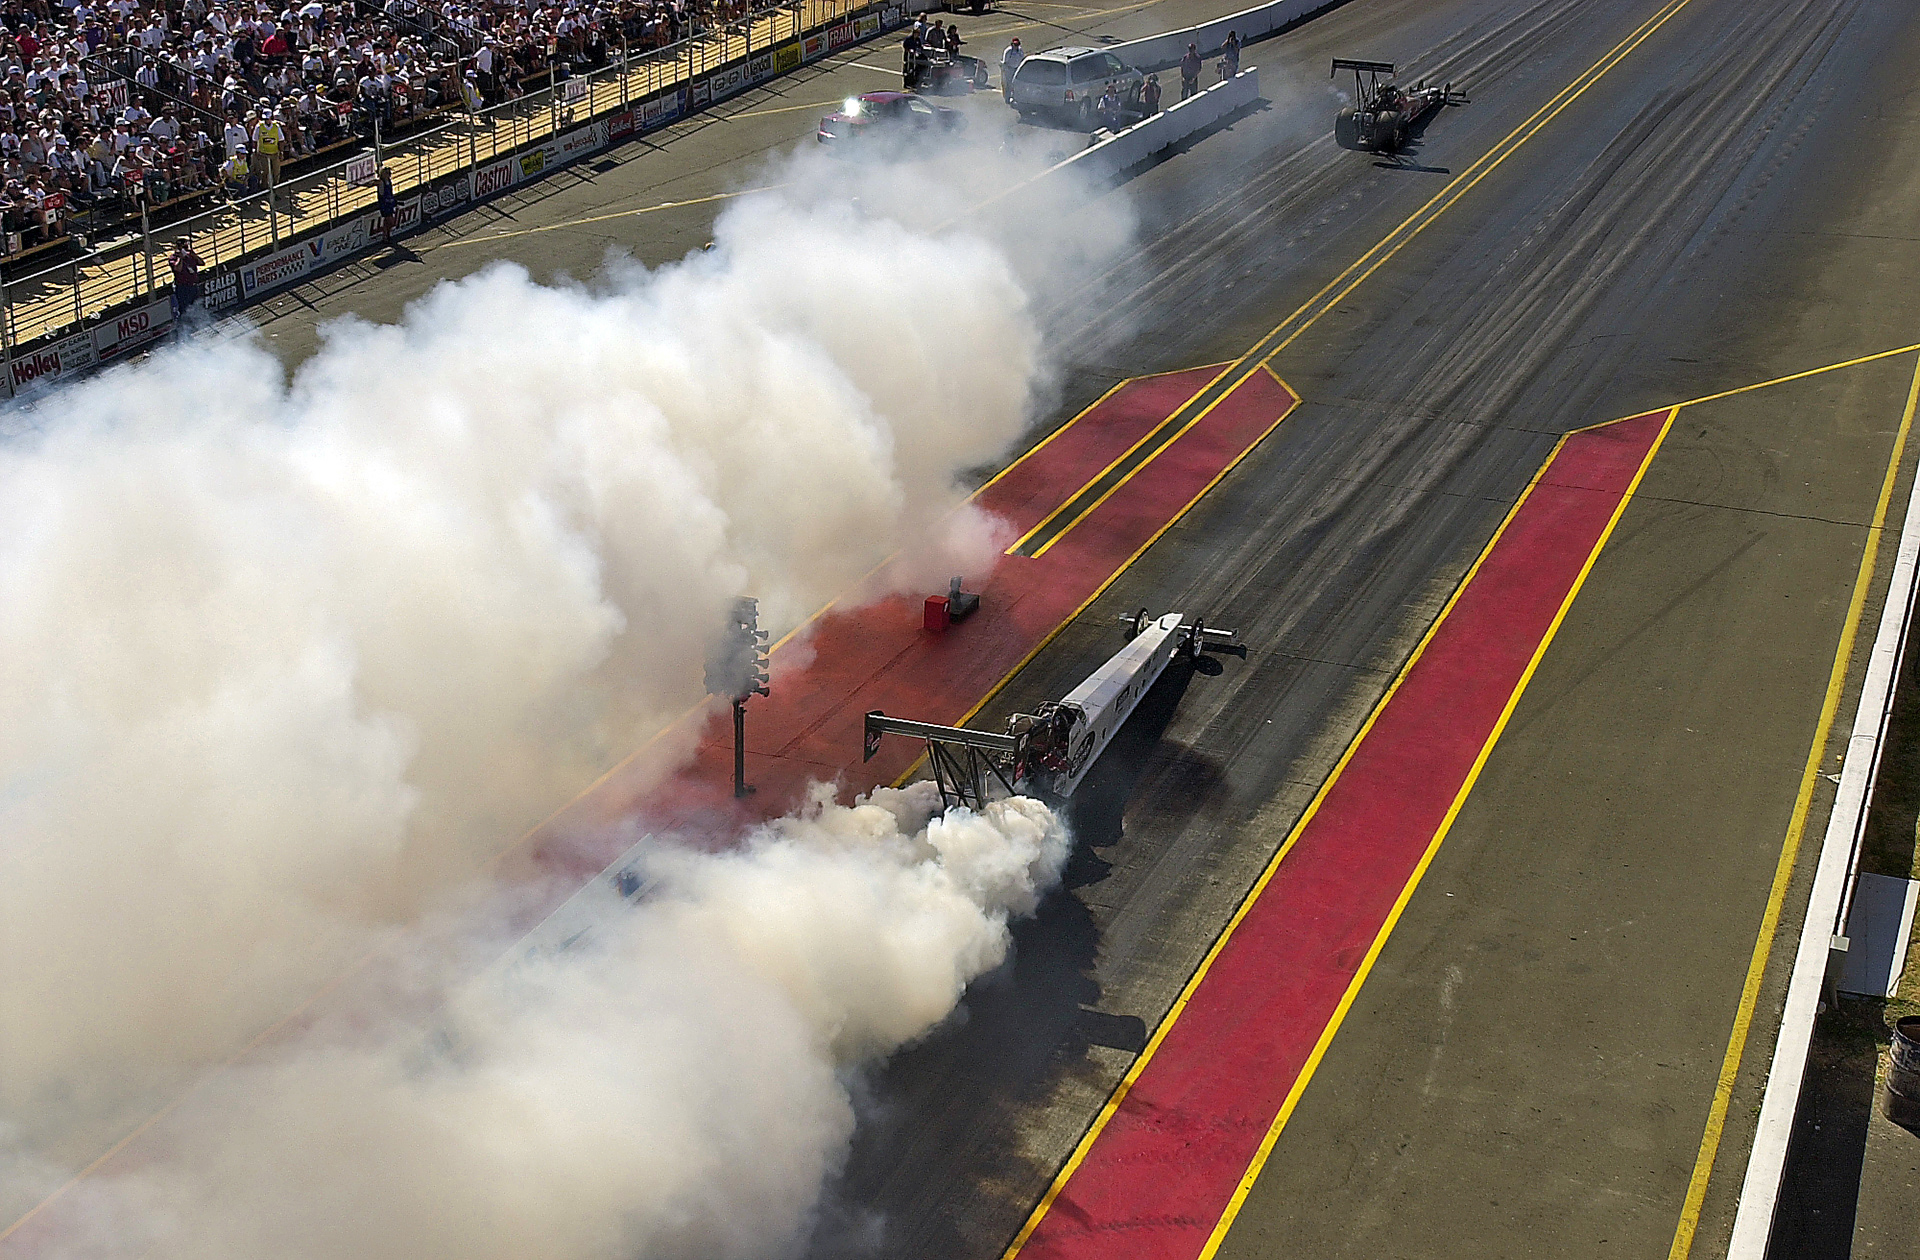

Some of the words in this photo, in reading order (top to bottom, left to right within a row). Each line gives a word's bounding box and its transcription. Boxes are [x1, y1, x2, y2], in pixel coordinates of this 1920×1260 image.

[830, 23, 853, 47] FRAM
[475, 160, 513, 197] Castrol
[255, 249, 305, 276] PERFORMANCE
[204, 273, 237, 295] SEALED
[257, 270, 278, 287] PARTS
[205, 286, 238, 309] POWER
[117, 312, 149, 340] MSD
[12, 351, 62, 386] Holley
